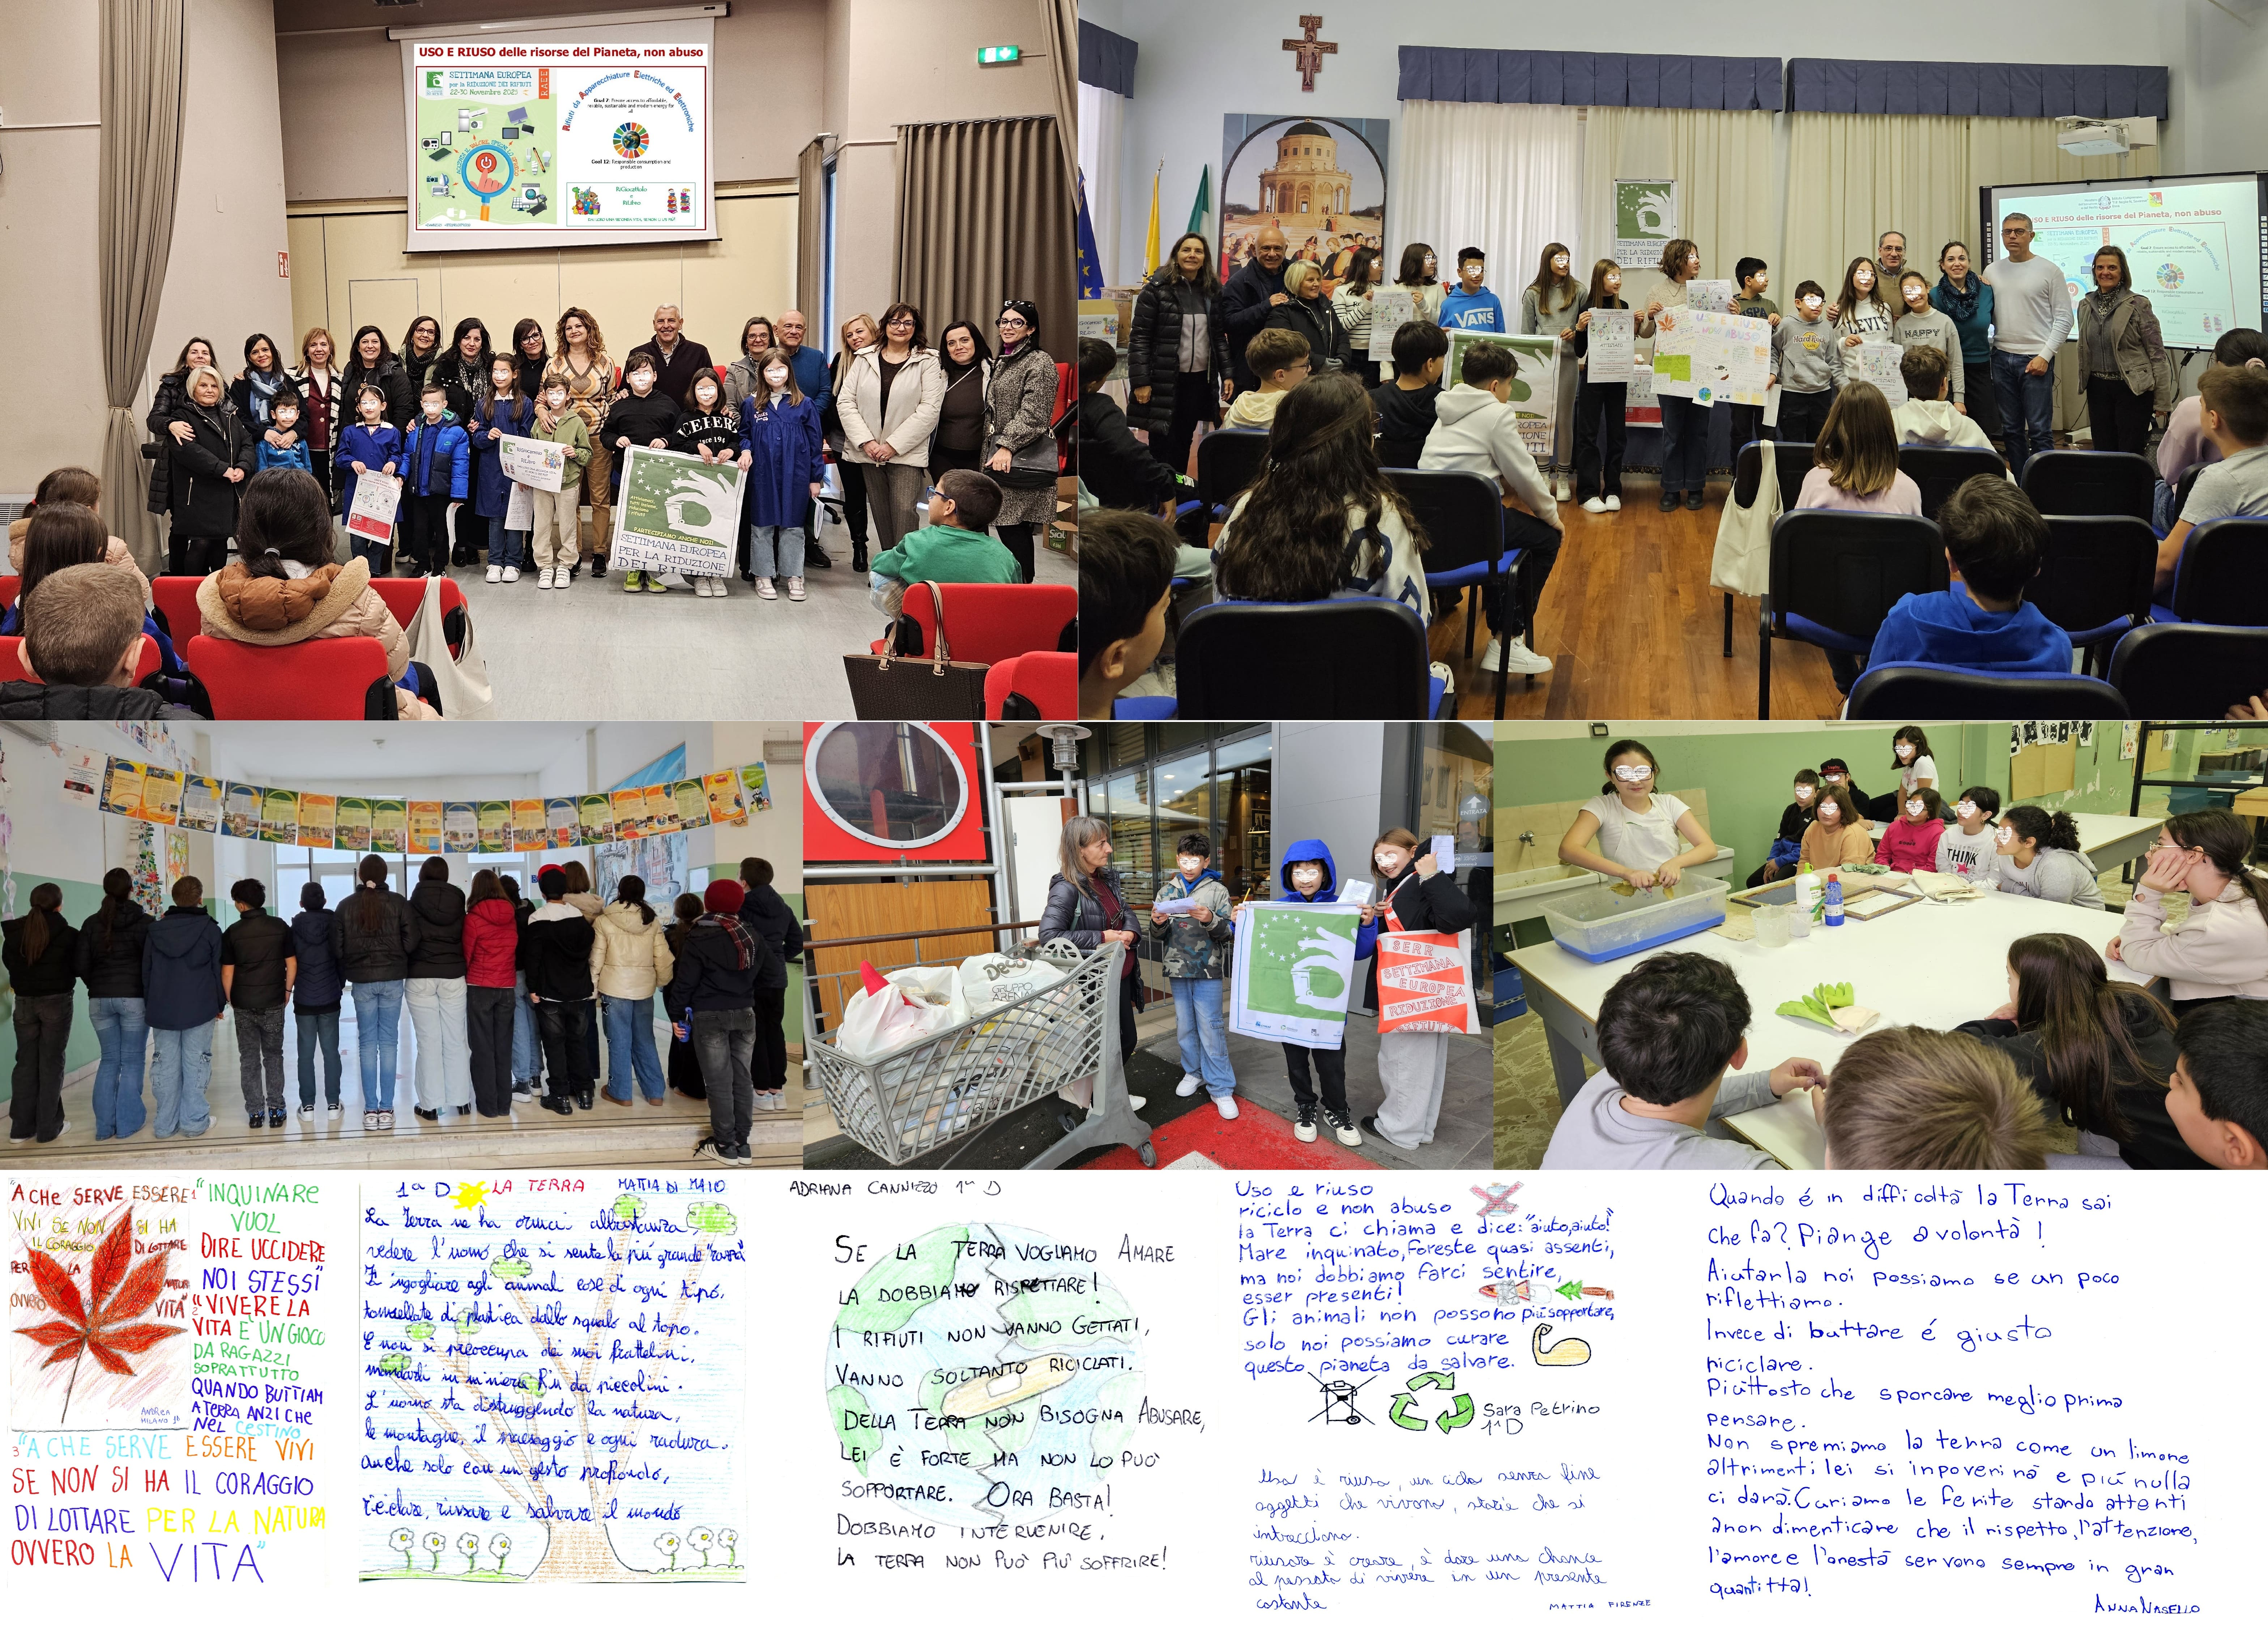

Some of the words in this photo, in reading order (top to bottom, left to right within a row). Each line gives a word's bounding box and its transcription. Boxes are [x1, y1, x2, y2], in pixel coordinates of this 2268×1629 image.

[419, 48, 443, 56] USO
[448, 48, 453, 56] E
[458, 48, 495, 56] RIUSO
[499, 47, 526, 56] delle
[531, 47, 569, 56] risorse
[573, 47, 589, 56] del
[594, 47, 640, 58] Pianeta,
[669, 47, 703, 56] abuso
[562, 110, 575, 131] Rifiuti
[574, 100, 580, 108] da
[579, 72, 630, 99] Apparecchiature
[634, 70, 665, 87] Elettriche
[674, 93, 694, 132] Elettroniche
[456, 153, 466, 174] ACCENDI
[491, 140, 507, 151] SPEGNI
[2169, 227, 2197, 239] Elettriche
[1454, 308, 1494, 328] VANS
[1696, 313, 1717, 324] USO
[1721, 316, 1727, 325] E
[1725, 328, 1760, 342] ABUSO
[1793, 334, 1811, 343] Hard
[1811, 335, 1826, 344] Rock
[1905, 328, 1940, 338] HAPPY
[634, 526, 676, 539] PARTECIPIAMO
[1049, 529, 1065, 539] Sial
[621, 534, 676, 551] SETTIMANA
[680, 544, 727, 559] EUROPEA
[618, 557, 647, 569] DEI
[619, 546, 639, 557] PER
[645, 551, 659, 560] LA
[665, 555, 725, 571] RIDUZIONE
[1948, 848, 1978, 867] THINK
[1393, 941, 1433, 955] SERR
[1384, 957, 1455, 978] SETTIMANA
[992, 983, 1032, 993] GRUPPO
[1399, 978, 1465, 996] EUROPEA
[1389, 995, 1457, 1017] RIDUZIONE
[1396, 1021, 1455, 1033] RIFIUTI
[493, 1180, 511, 1194] LA
[529, 1179, 584, 1192] TERRA
[666, 1181, 678, 1194] DI
[1236, 1181, 1272, 1197] Uso
[1288, 1186, 1304, 1196] e
[1316, 1184, 1373, 1196] riuso
[1240, 1199, 1301, 1218] riciclo
[1317, 1205, 1328, 1215] e
[1342, 1203, 1373, 1214] non
[1391, 1197, 1451, 1214] abuso
[202, 1236, 242, 1258] DIRE
[252, 1239, 325, 1262] UCCIDERE
[896, 1244, 917, 1261] LA
[951, 1241, 1005, 1260] TERRA
[1708, 1318, 1765, 1341] Invece
[1774, 1321, 1791, 1339] di
[1809, 1320, 1903, 1339] buttare
[1957, 1314, 2051, 1352] giusto
[1483, 1403, 1521, 1417] Sara
[1531, 1402, 1599, 1415] Petrino
[840, 1441, 866, 1462] LEI
[922, 1450, 971, 1466] FORTE
[993, 1452, 1018, 1467] MA
[1041, 1453, 1075, 1466] NON
[1090, 1453, 1113, 1468] LO
[13, 1468, 39, 1494] SE
[52, 1465, 98, 1496] NON
[112, 1466, 128, 1492] SI
[145, 1470, 169, 1492] HA
[186, 1470, 201, 1495] IL
[216, 1472, 313, 1495] CORAGGIO
